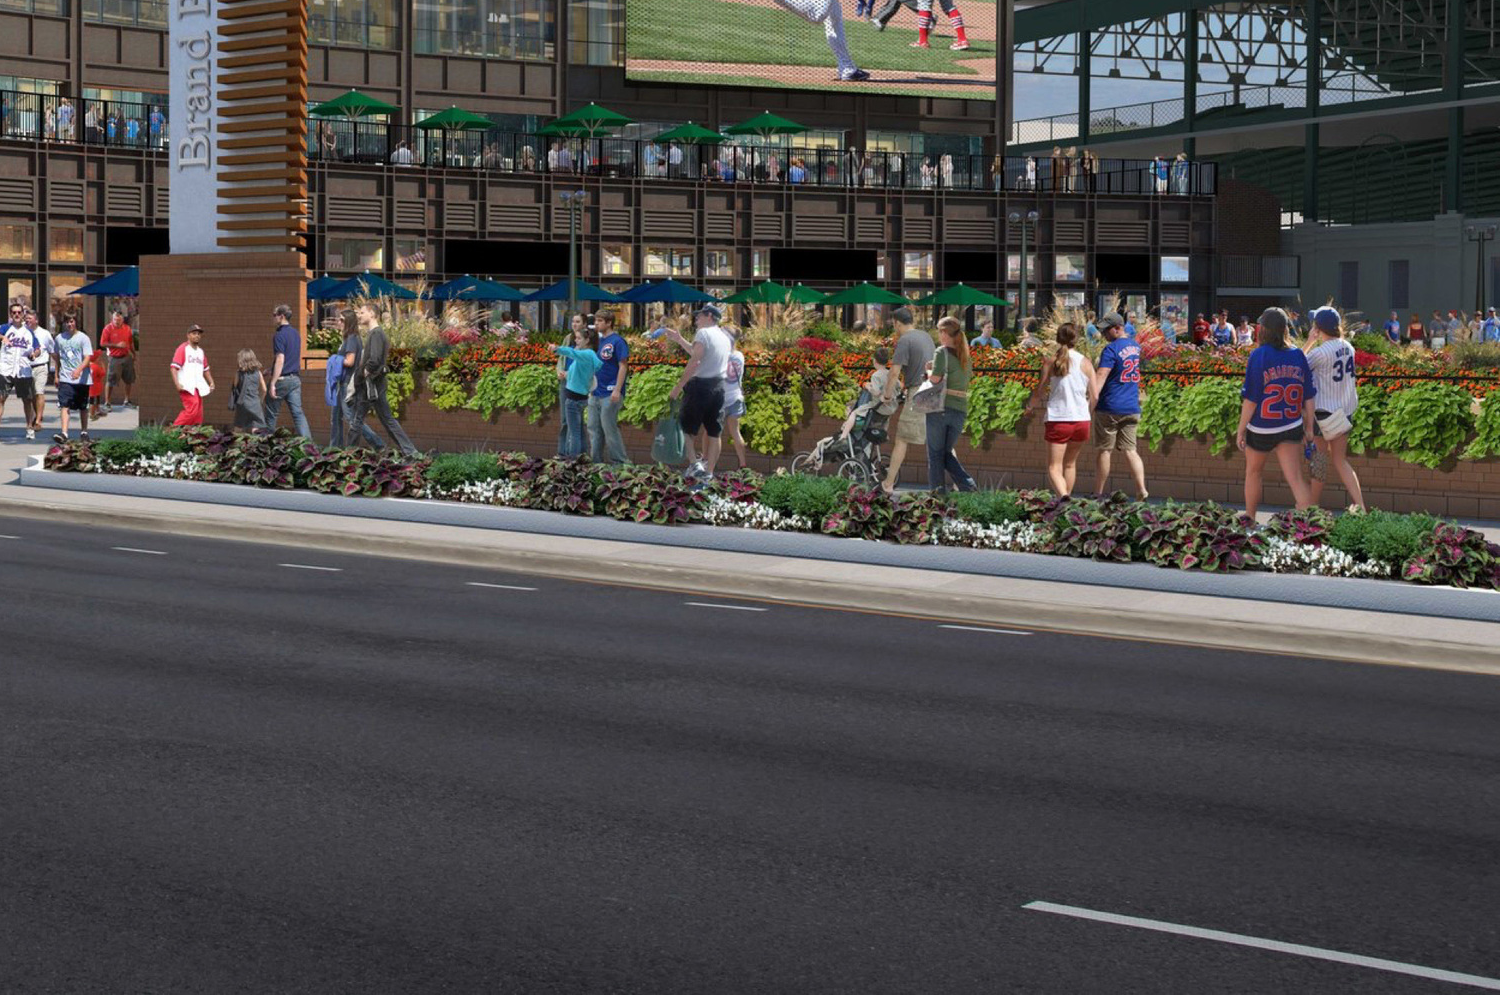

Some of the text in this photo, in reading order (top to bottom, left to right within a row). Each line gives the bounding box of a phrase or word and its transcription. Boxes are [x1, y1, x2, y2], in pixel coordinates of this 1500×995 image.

[178, 30, 212, 172] Brand
[1332, 356, 1356, 383] 34
[1260, 383, 1304, 420] 29
